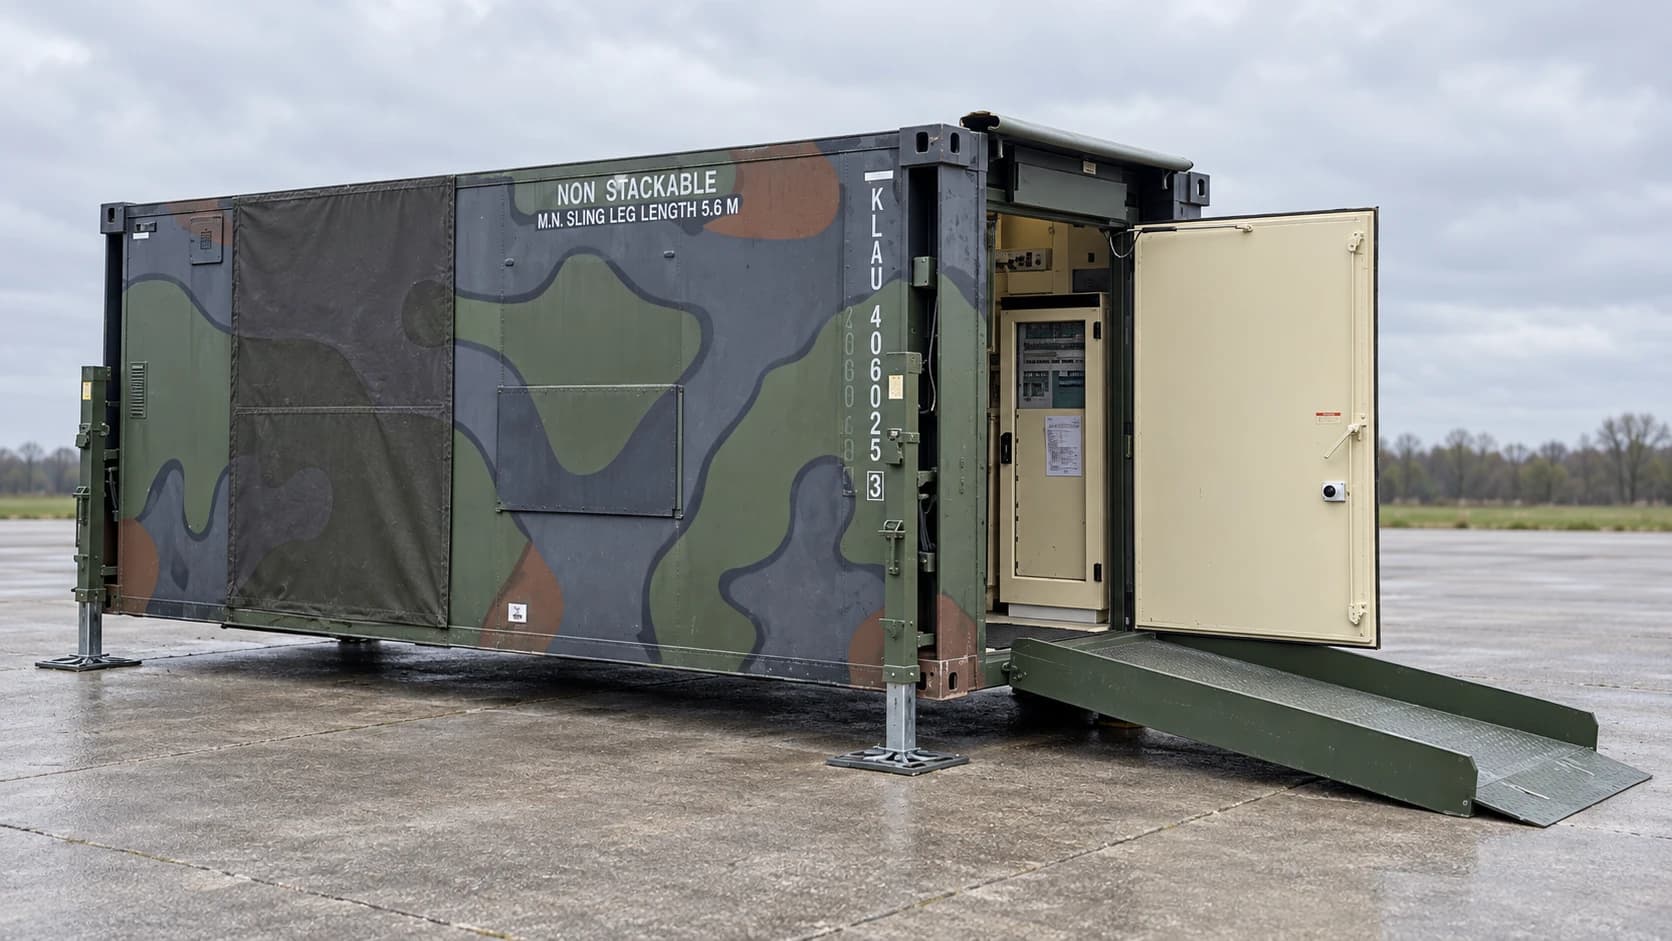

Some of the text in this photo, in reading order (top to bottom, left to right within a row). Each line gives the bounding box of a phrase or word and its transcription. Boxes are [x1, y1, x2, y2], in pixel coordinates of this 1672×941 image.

[557, 170, 717, 206] NON STACKABLE
[537, 197, 739, 230] M.N. SLING LEG LENGTH 5.6 M
[870, 187, 884, 498] KLAU 406025 3
